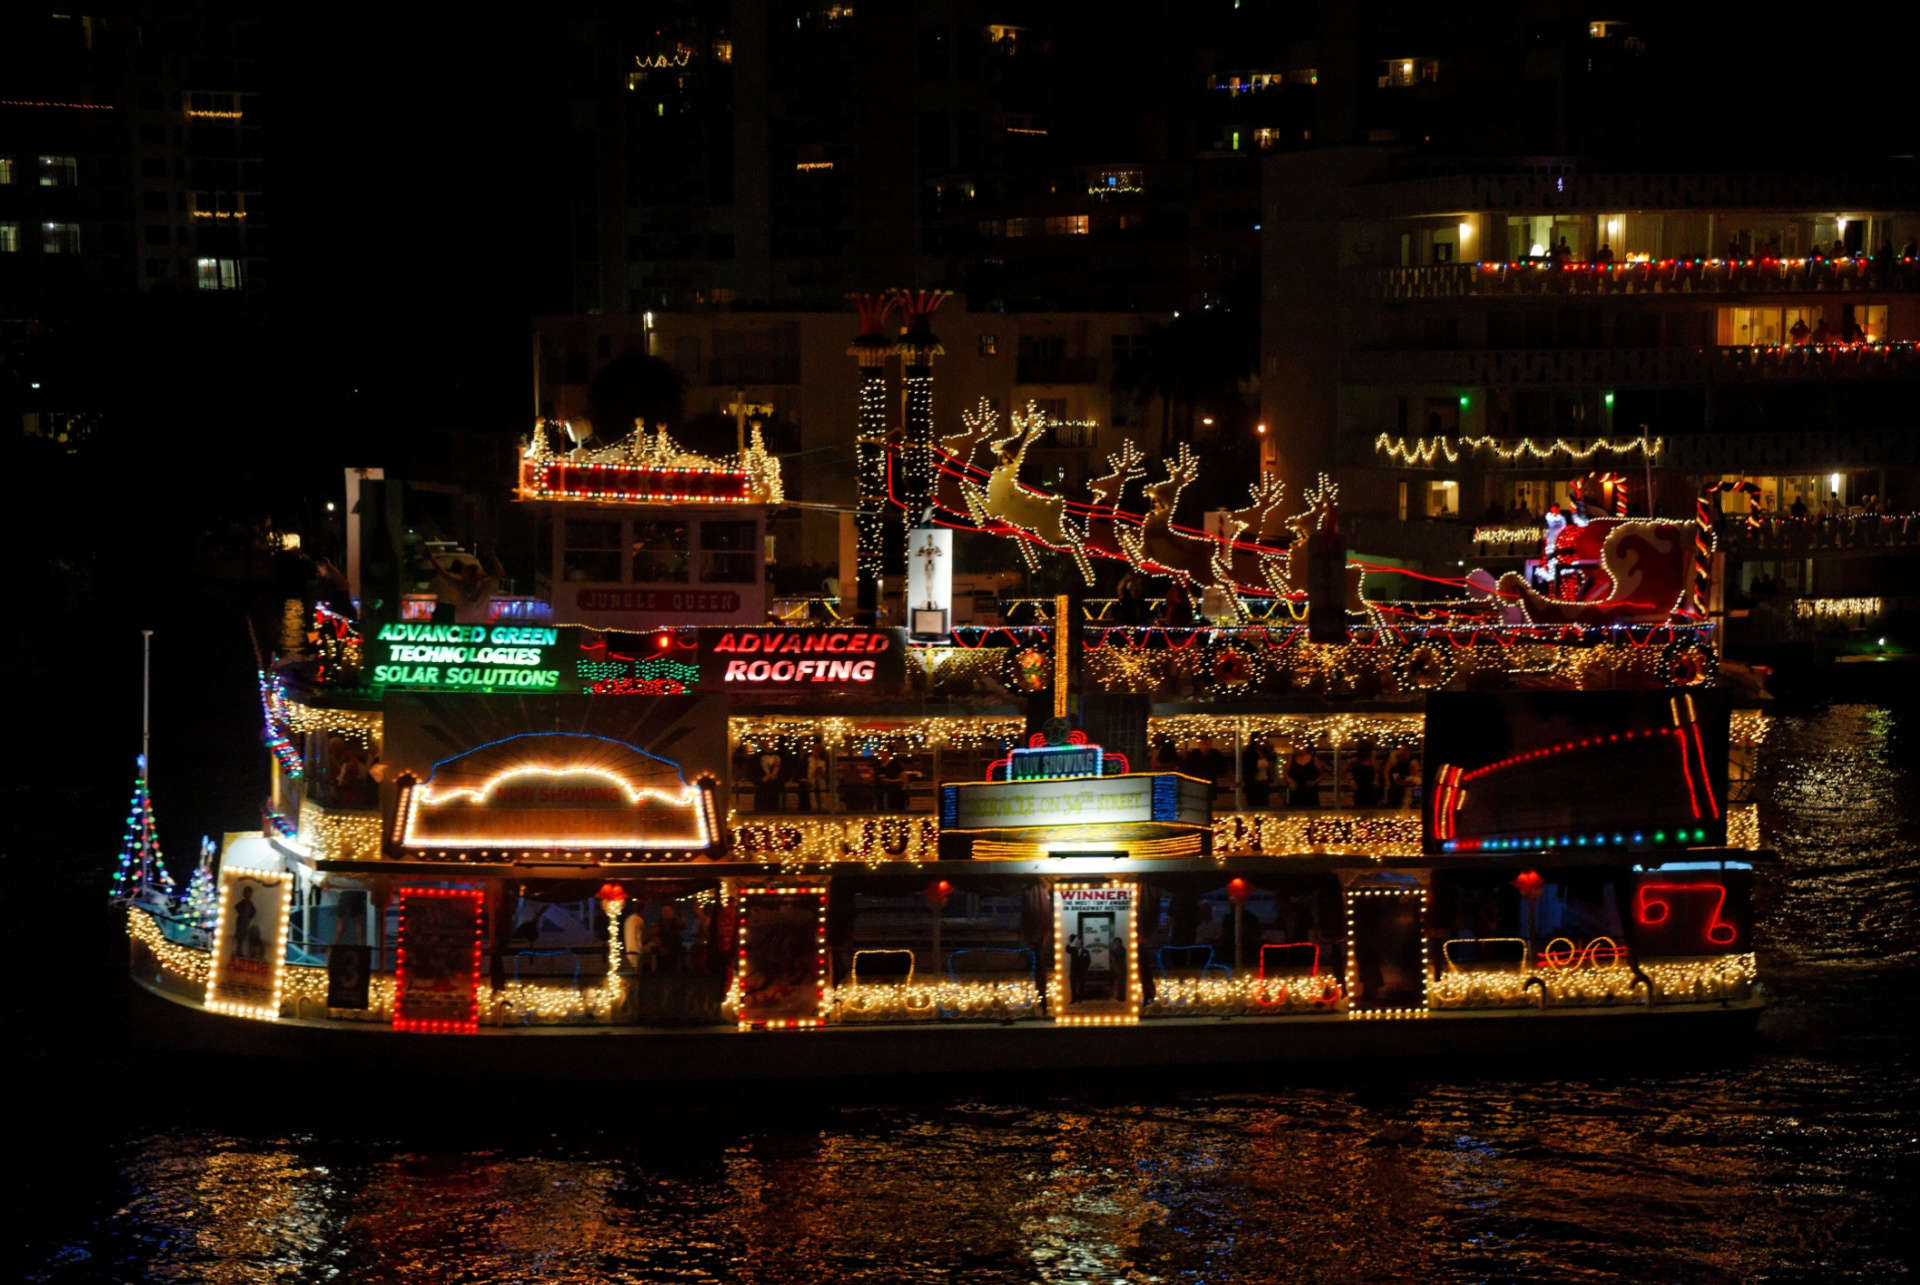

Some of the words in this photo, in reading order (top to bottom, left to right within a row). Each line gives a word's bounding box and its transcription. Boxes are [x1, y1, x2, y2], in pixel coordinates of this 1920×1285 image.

[578, 471, 714, 494] TICKETS
[586, 592, 657, 609] JUNGLE
[672, 593, 734, 610] QUEEN
[377, 622, 485, 643] ADVANCED
[491, 625, 558, 647] GREEN
[713, 632, 889, 654] ADVANCED
[389, 644, 542, 666] TECHNOLOGIES
[373, 665, 440, 684] SOLAR
[444, 667, 560, 688] SOLUTIONS
[724, 659, 876, 683] ROOFING
[1014, 757, 1038, 774] NOW
[1041, 753, 1094, 772] SHOWING
[496, 787, 533, 802] NOW
[537, 787, 620, 803] SHOWING
[1040, 796, 1060, 814] ON
[1096, 792, 1142, 811] STREET
[1061, 890, 1132, 901] WINNER!
